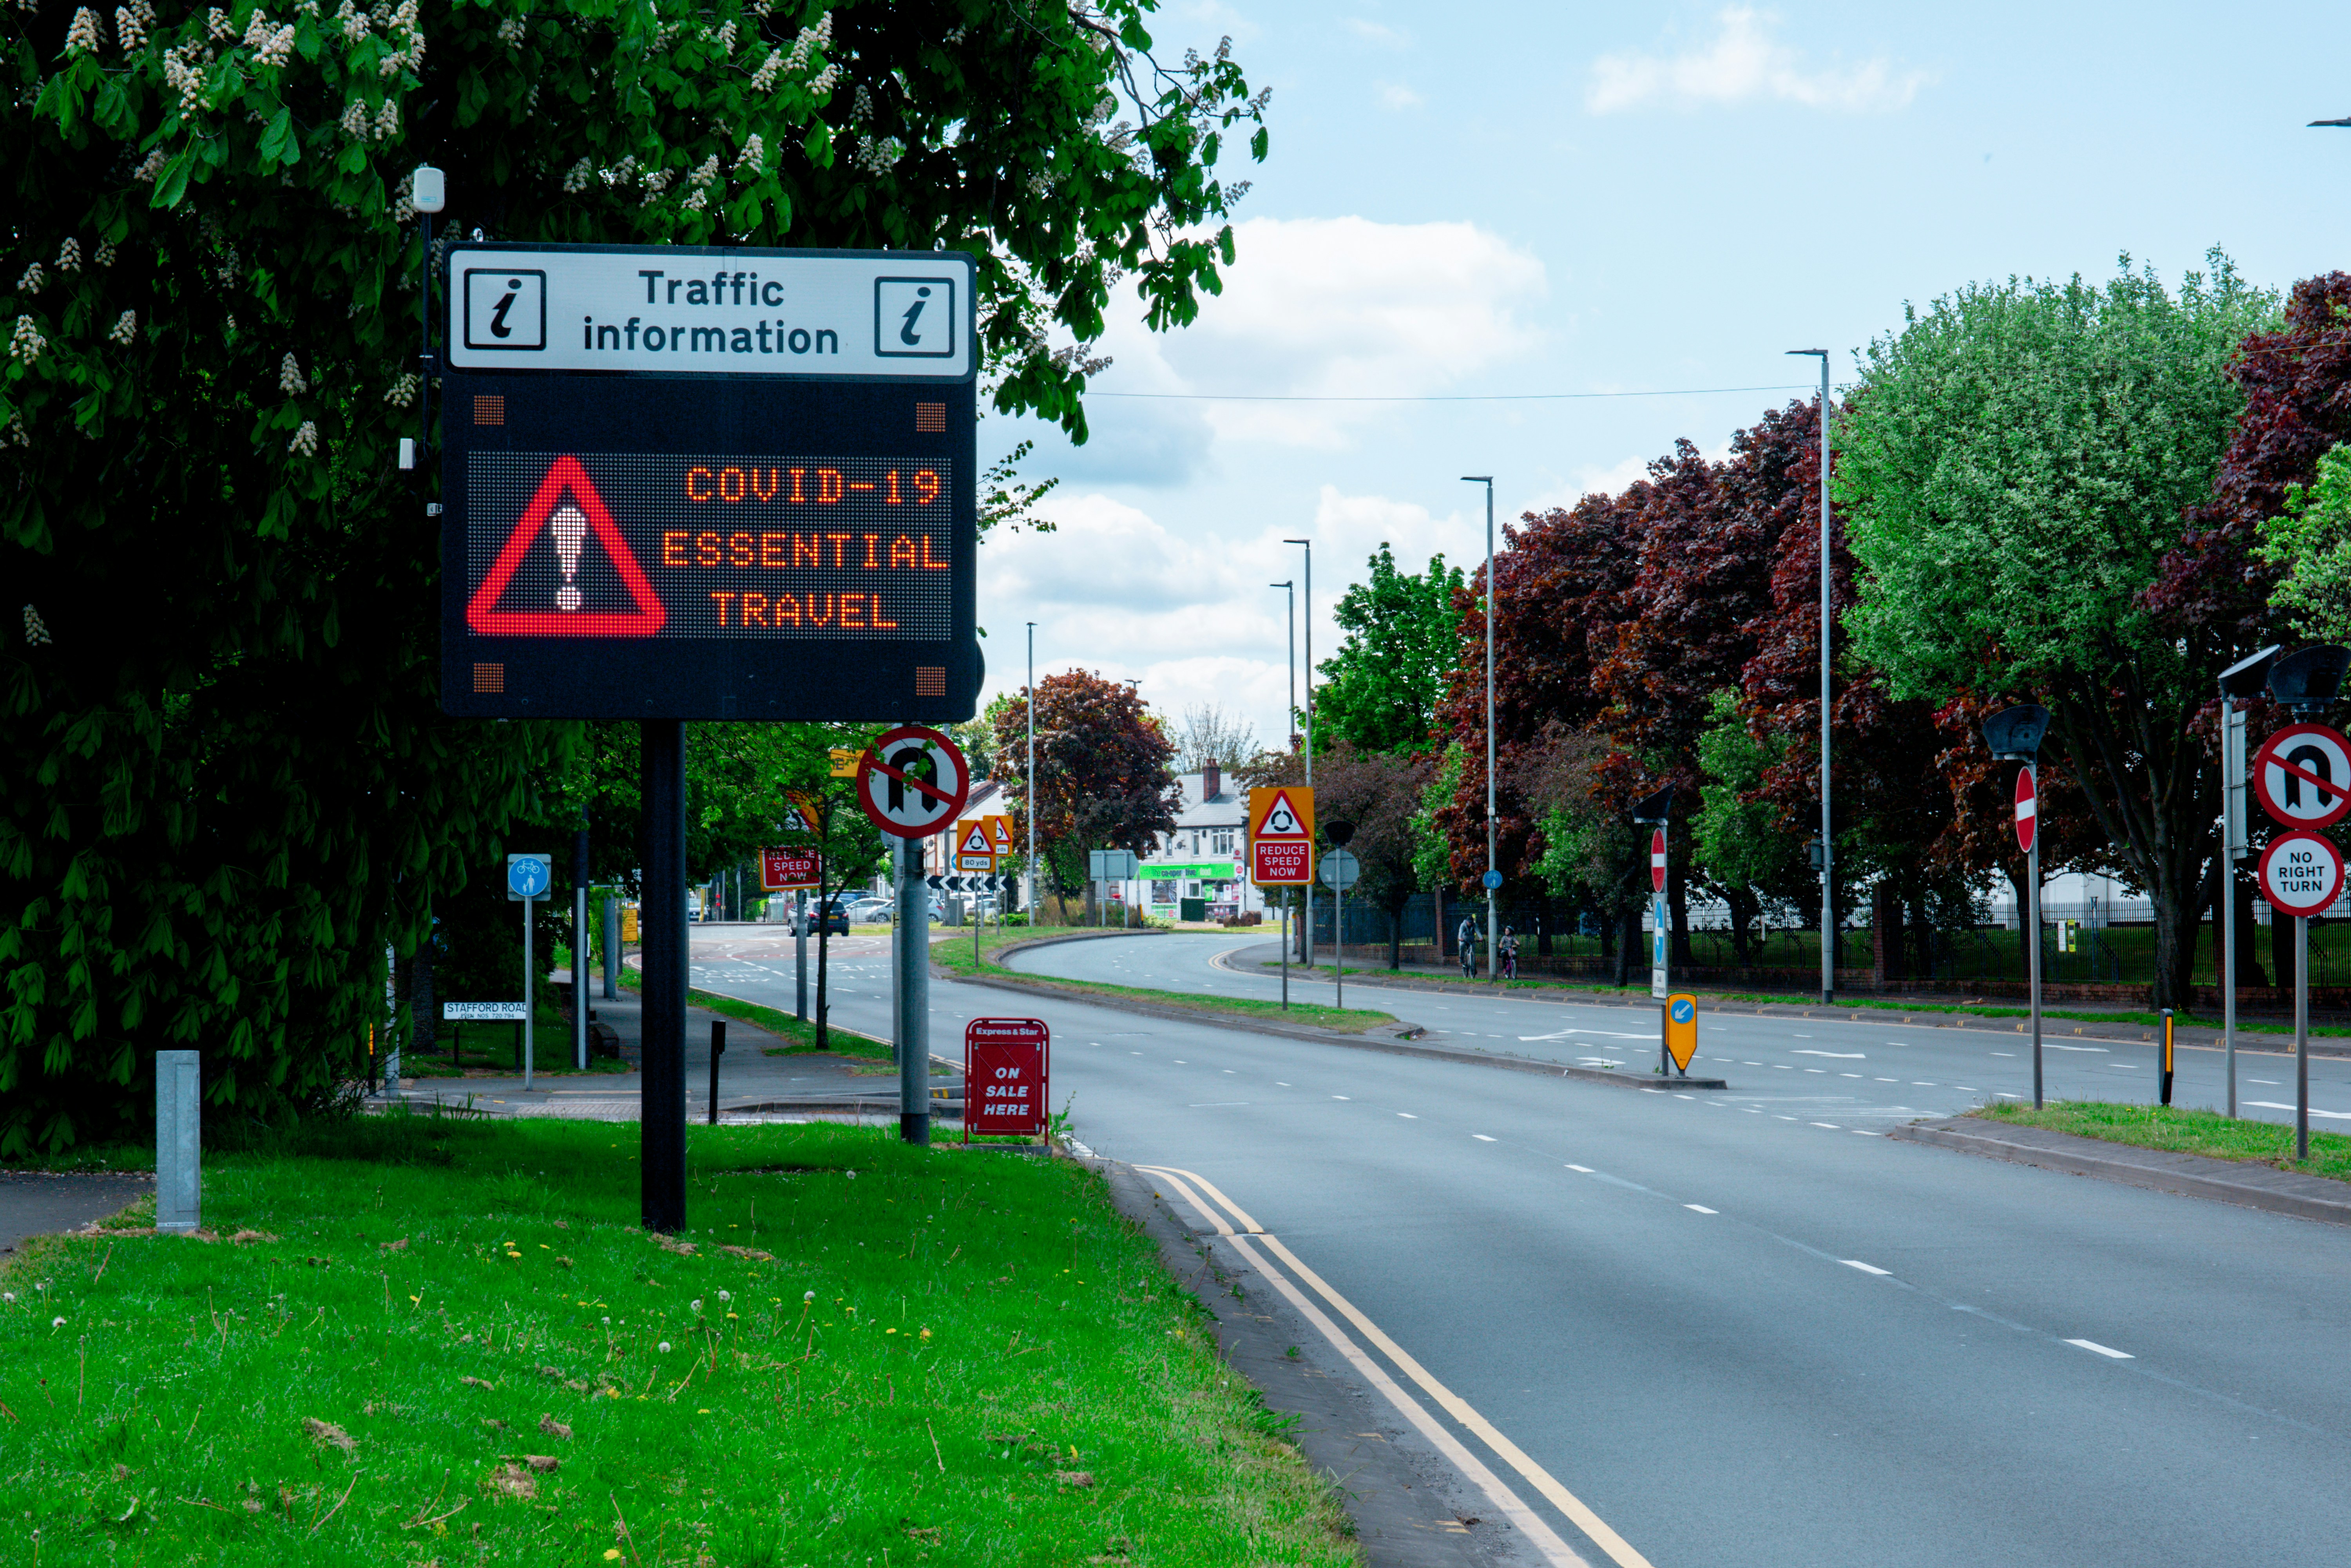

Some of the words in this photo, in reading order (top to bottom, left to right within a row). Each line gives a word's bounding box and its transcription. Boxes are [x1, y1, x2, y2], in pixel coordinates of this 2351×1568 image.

[639, 270, 784, 307] Traffic
[584, 316, 838, 354] information
[687, 467, 939, 504] COVID-19
[663, 531, 948, 568] ESSENTIAL
[711, 592, 898, 628] TRAVEL
[1260, 846, 1305, 855] REDUCE
[1264, 856, 1301, 865] SPEED
[2290, 852, 2312, 863] NO
[773, 861, 811, 871] SPEED
[1270, 867, 1296, 876] NOW
[2279, 866, 2325, 878] RIGHT
[2280, 880, 2322, 892] TURN
[447, 1003, 499, 1012] STAFFORD
[976, 1027, 1012, 1036] Express
[995, 1067, 1020, 1079] ON
[985, 1085, 1029, 1097] SALE
[984, 1104, 1030, 1115] HERE
